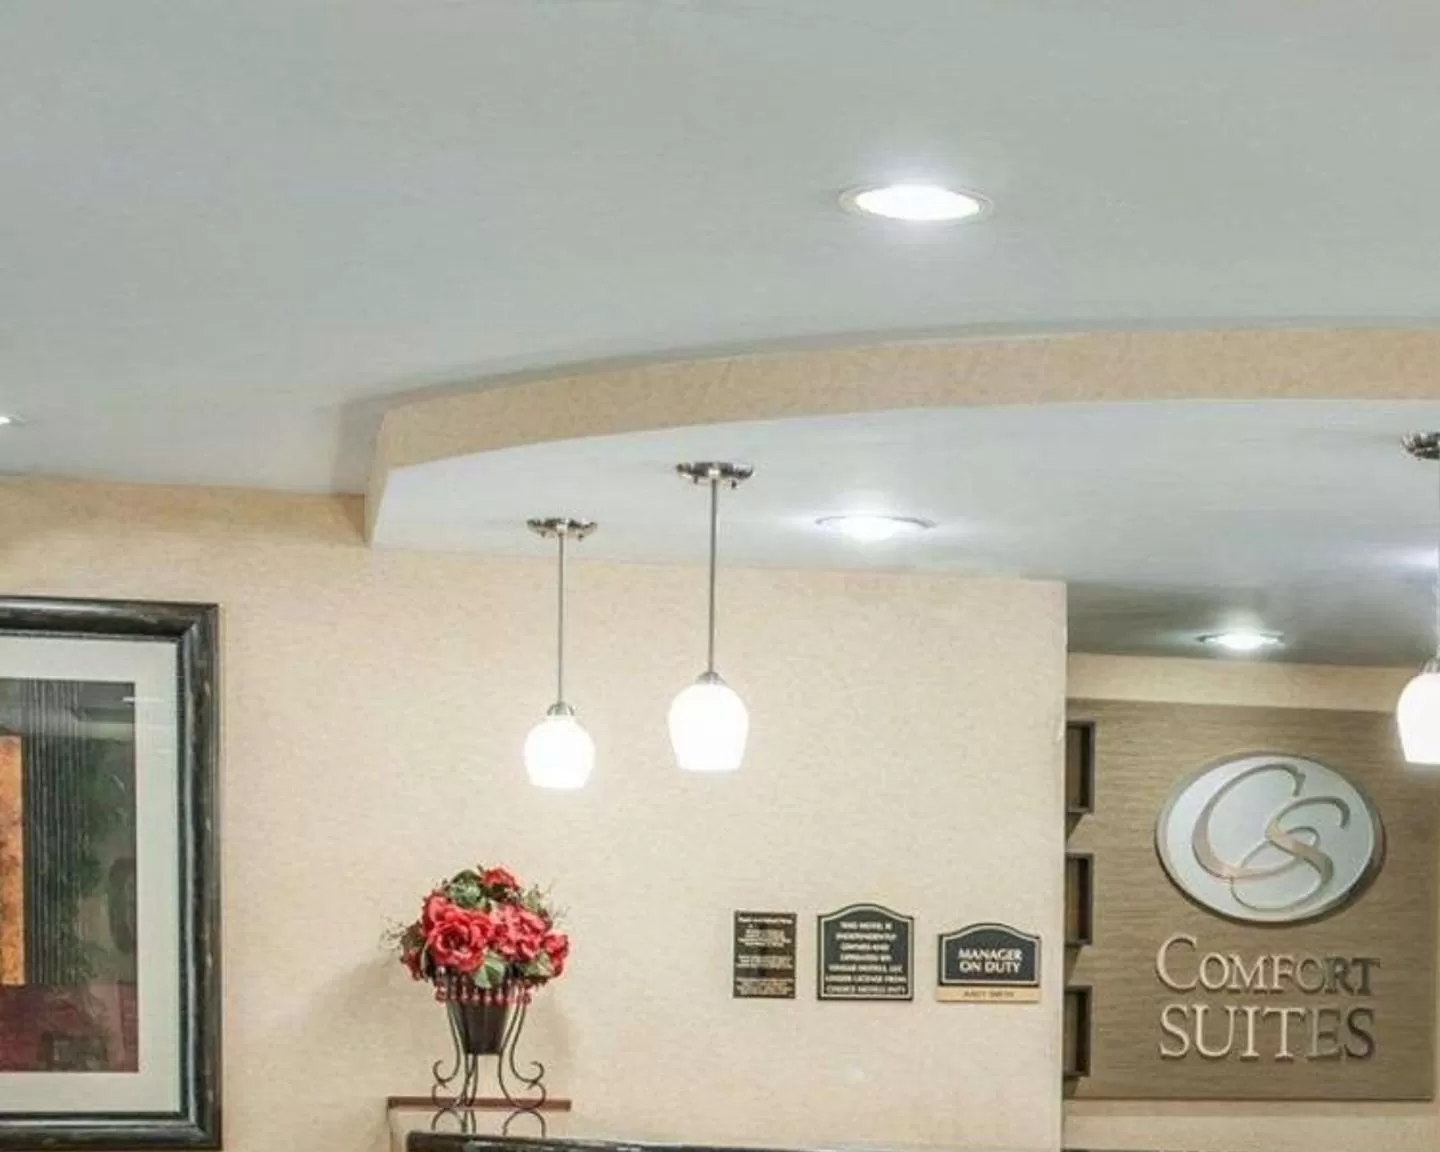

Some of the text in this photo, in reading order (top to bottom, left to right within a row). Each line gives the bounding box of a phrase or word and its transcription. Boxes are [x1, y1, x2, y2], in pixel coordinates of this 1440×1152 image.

[957, 947, 1023, 961] MANAGER
[959, 960, 1021, 973] ON DUTY
[1158, 1004, 1377, 1063] SUITES
